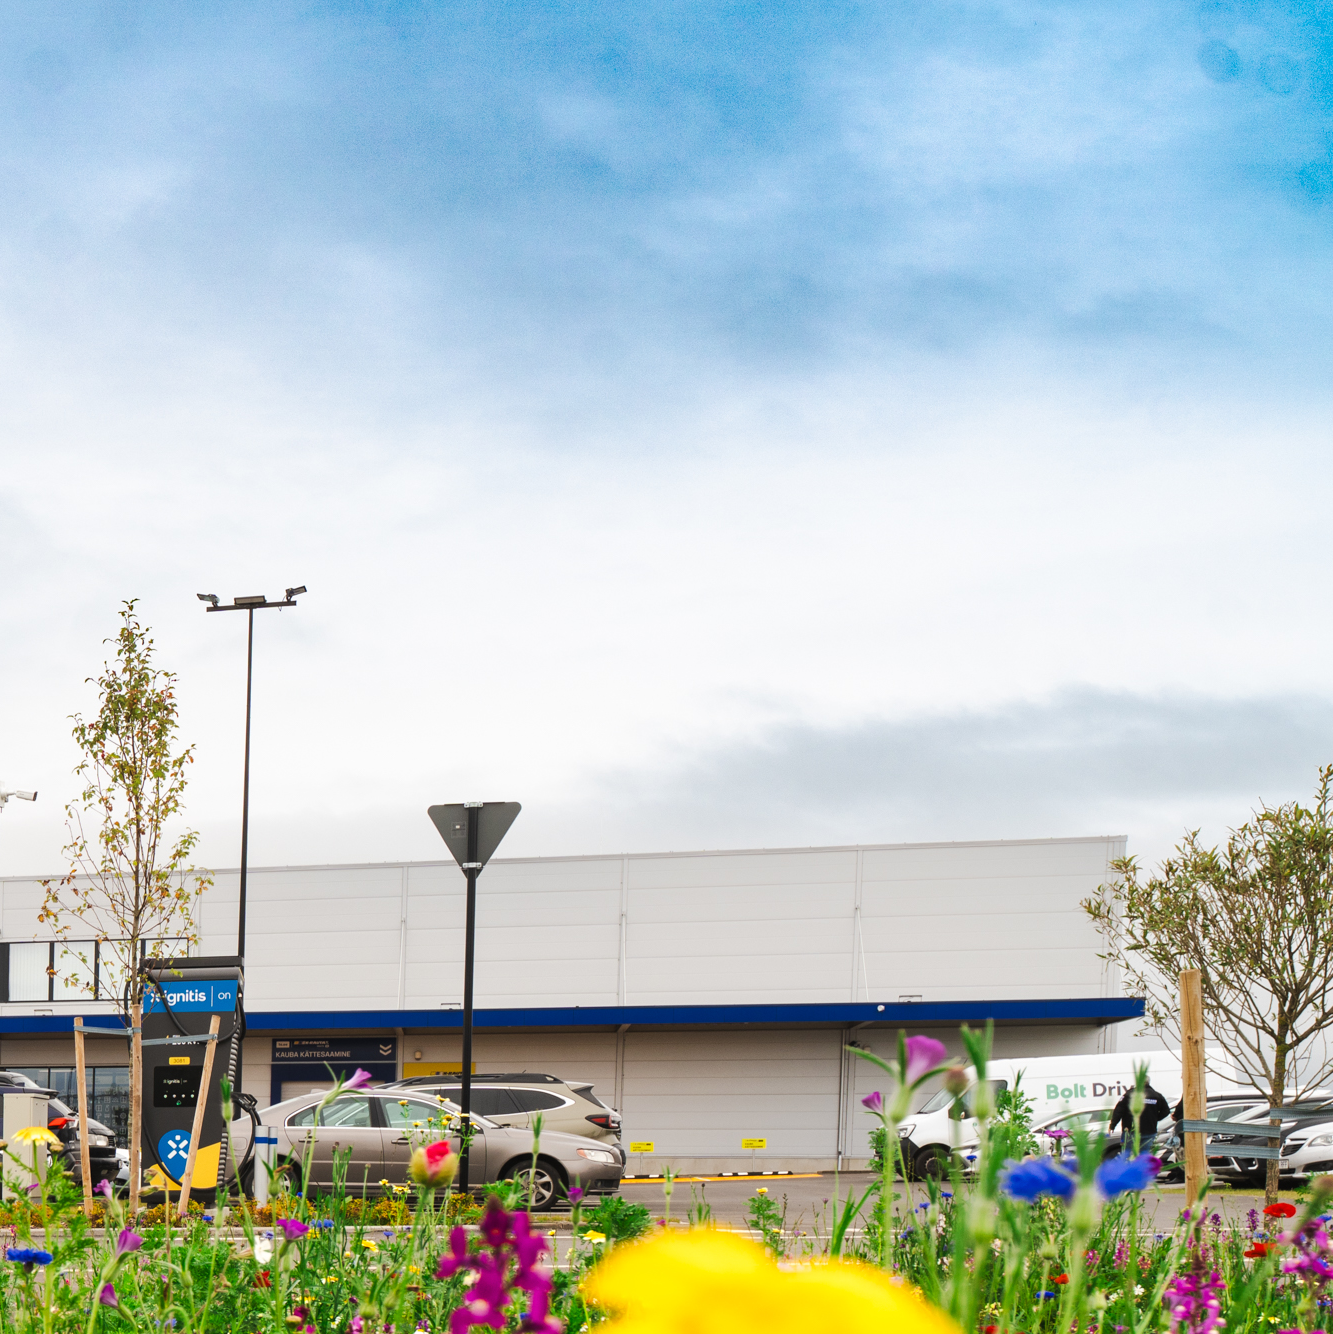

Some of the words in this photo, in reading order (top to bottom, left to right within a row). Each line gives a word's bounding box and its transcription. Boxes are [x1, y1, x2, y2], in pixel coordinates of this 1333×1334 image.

[161, 989, 206, 1006] ignitis
[218, 992, 231, 1000] on
[300, 1050, 351, 1058] KÄTTESAAMINE
[1046, 1083, 1086, 1103] Bolt
